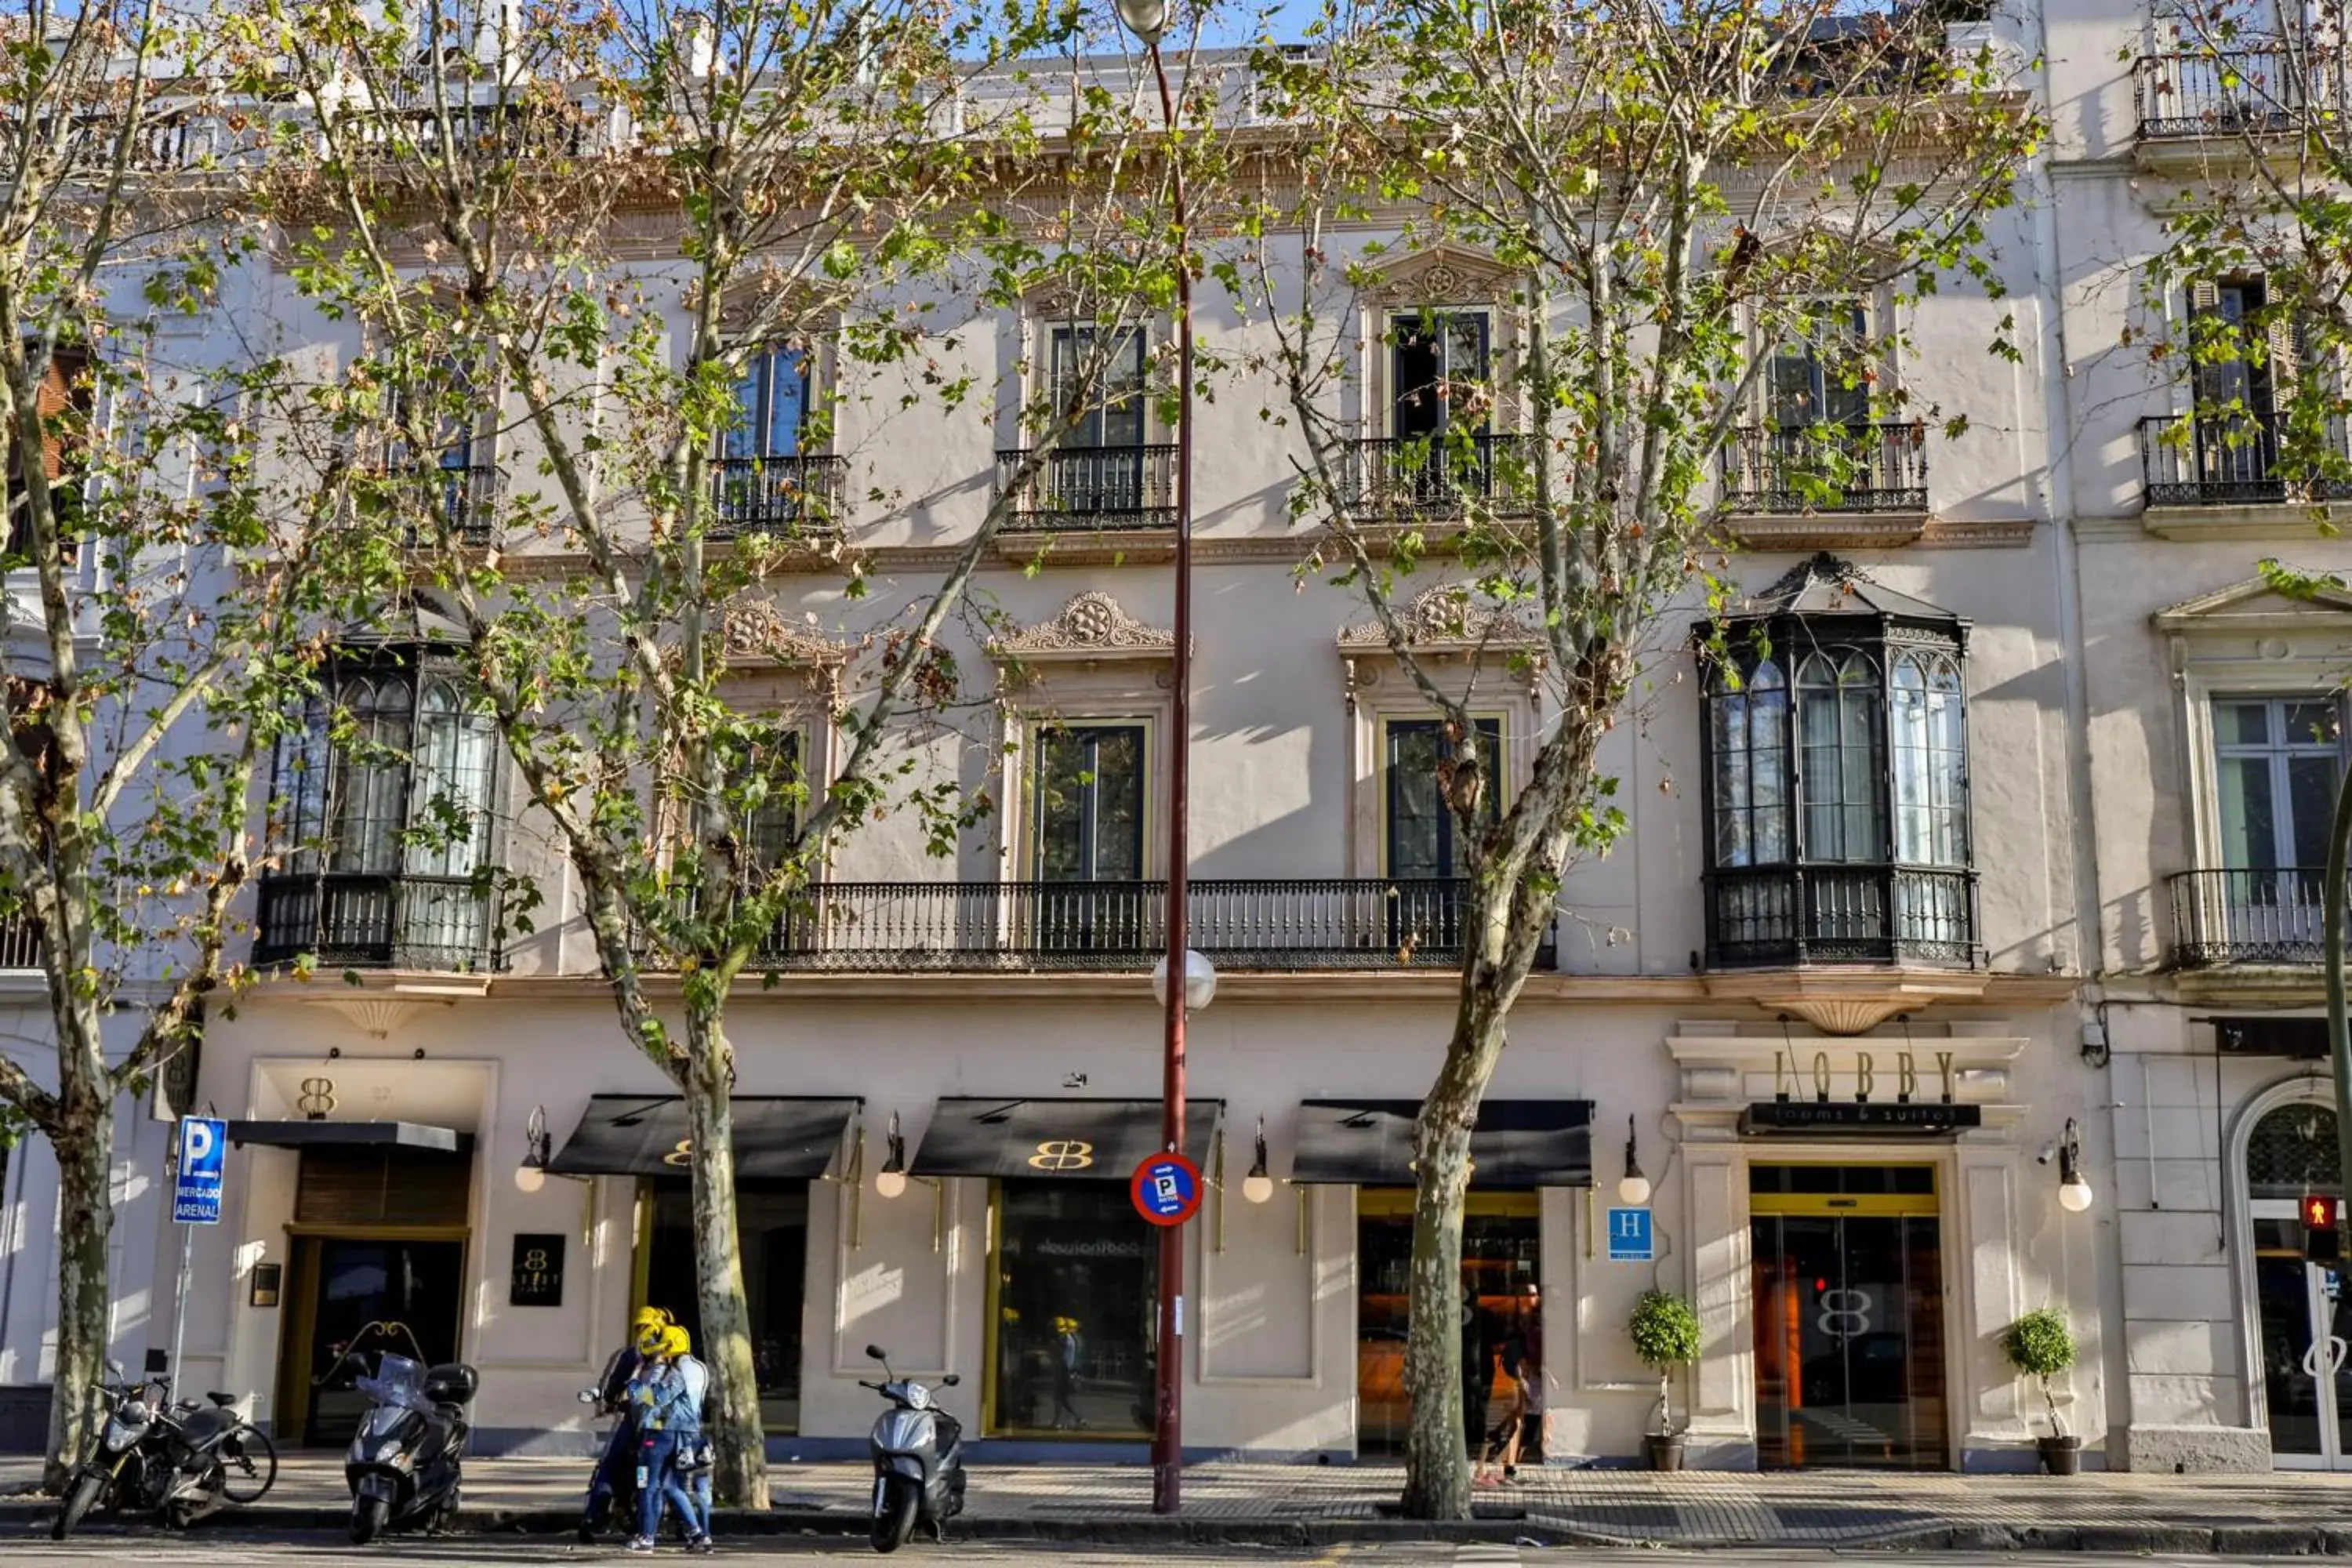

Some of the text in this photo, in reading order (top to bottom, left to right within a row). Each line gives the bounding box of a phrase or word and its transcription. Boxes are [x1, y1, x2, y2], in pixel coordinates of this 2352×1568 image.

[1774, 1051, 1953, 1095] LOBBY
[1775, 1108, 1844, 1120] rooms
[1884, 1106, 1956, 1122] suites
[183, 1122, 212, 1177] P
[177, 1185, 220, 1199] MERCADO
[1160, 1178, 1171, 1195] P
[176, 1203, 218, 1218] ARENAL
[1619, 1213, 1641, 1237] H
